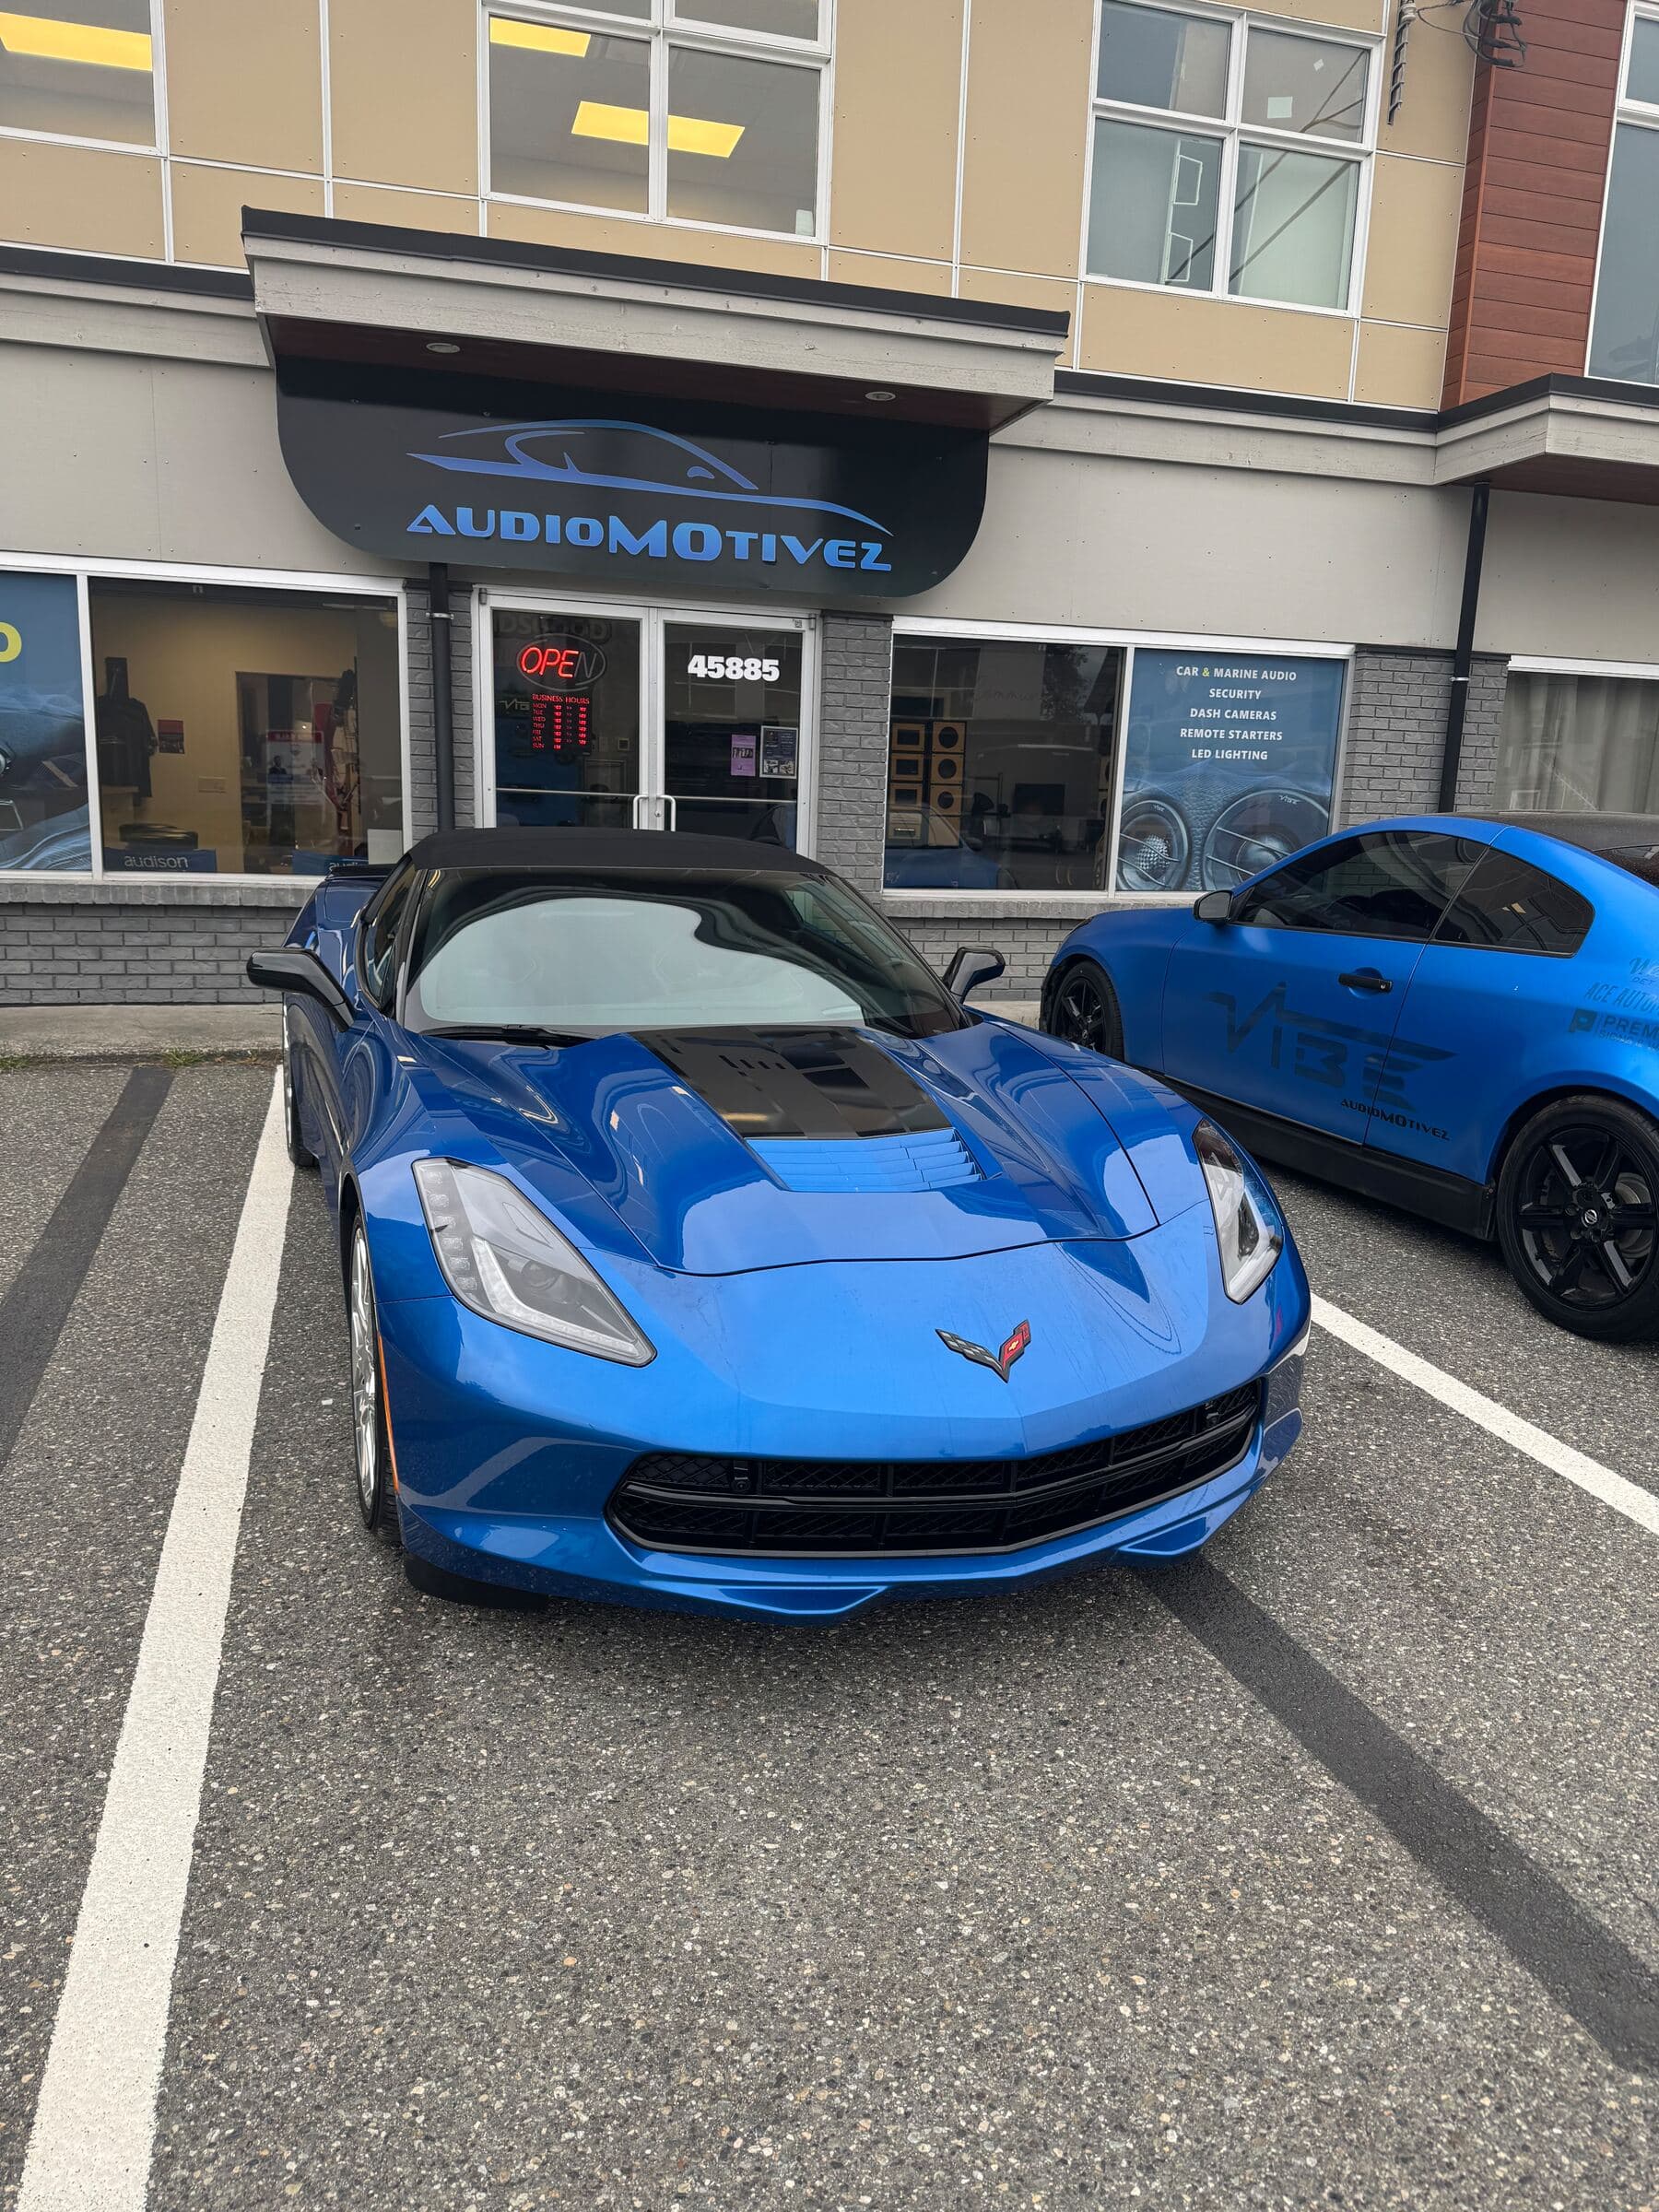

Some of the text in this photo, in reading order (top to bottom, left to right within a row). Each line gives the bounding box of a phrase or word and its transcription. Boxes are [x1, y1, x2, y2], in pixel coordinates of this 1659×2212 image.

[406, 504, 892, 571] AUDIOMOTIVEZ
[521, 647, 598, 678] OPEN
[688, 655, 780, 681] 45885
[1176, 666, 1297, 680] CAR & MARINE AUDIO
[532, 694, 563, 702] BUSINESS
[1209, 688, 1261, 700] SECURITY
[1190, 708, 1277, 721] DASH CAMERAS
[1180, 728, 1283, 740] REMOTE STARTERS
[1192, 749, 1268, 760] LED LIGHTING
[124, 853, 189, 870] audison
[1584, 982, 1618, 1004] ACE
[1341, 1099, 1451, 1141] AUDIOMOTIVEZ
